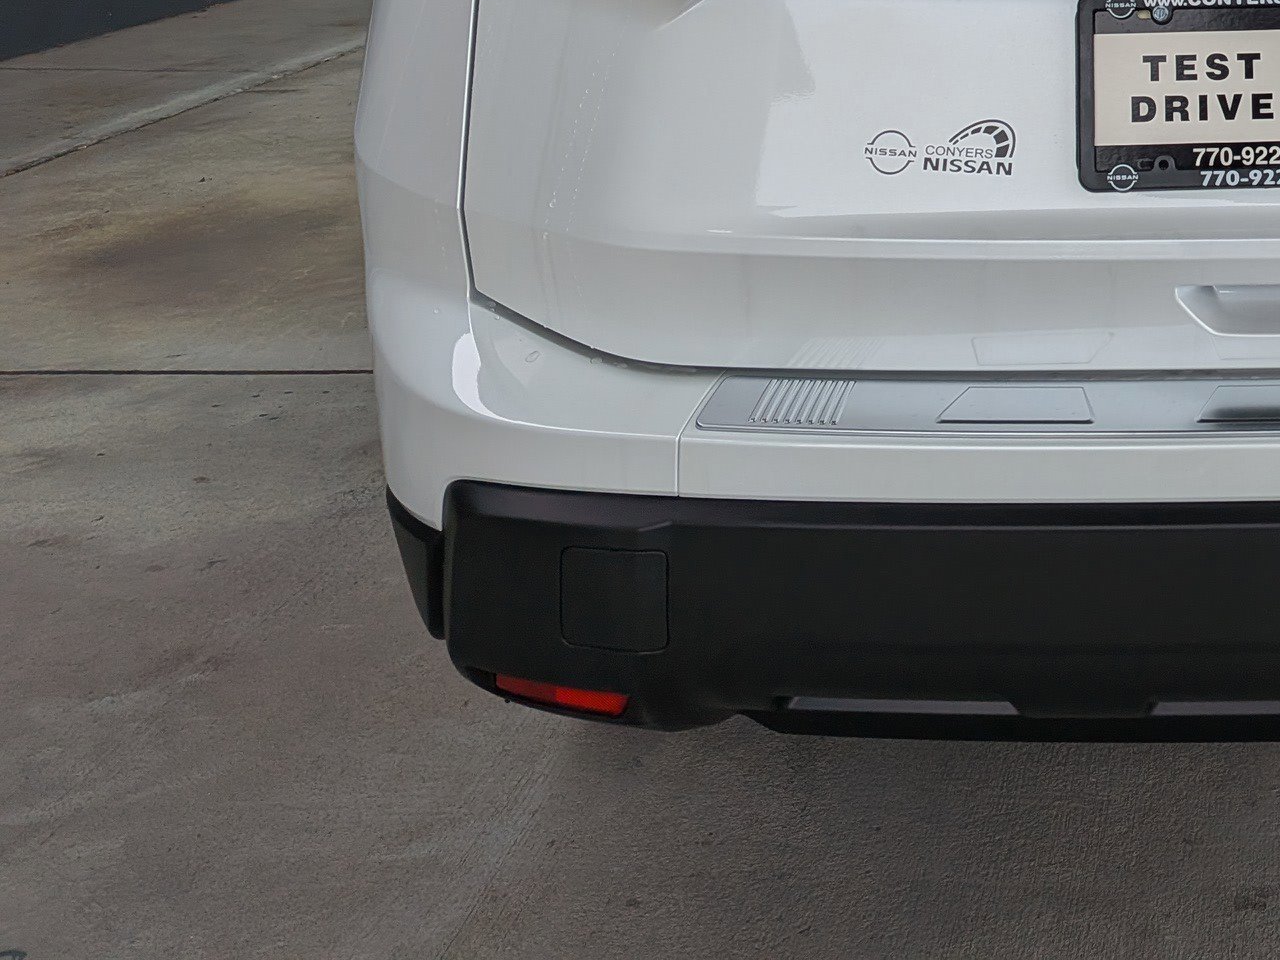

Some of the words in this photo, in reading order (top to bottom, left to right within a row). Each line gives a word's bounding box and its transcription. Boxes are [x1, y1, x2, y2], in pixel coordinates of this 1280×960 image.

[1142, 52, 1262, 83] TEST
[1130, 93, 1275, 123] DRIVE
[864, 146, 918, 158] NISSAN
[925, 144, 994, 159] CONYERS
[922, 157, 1013, 176] NISSAN
